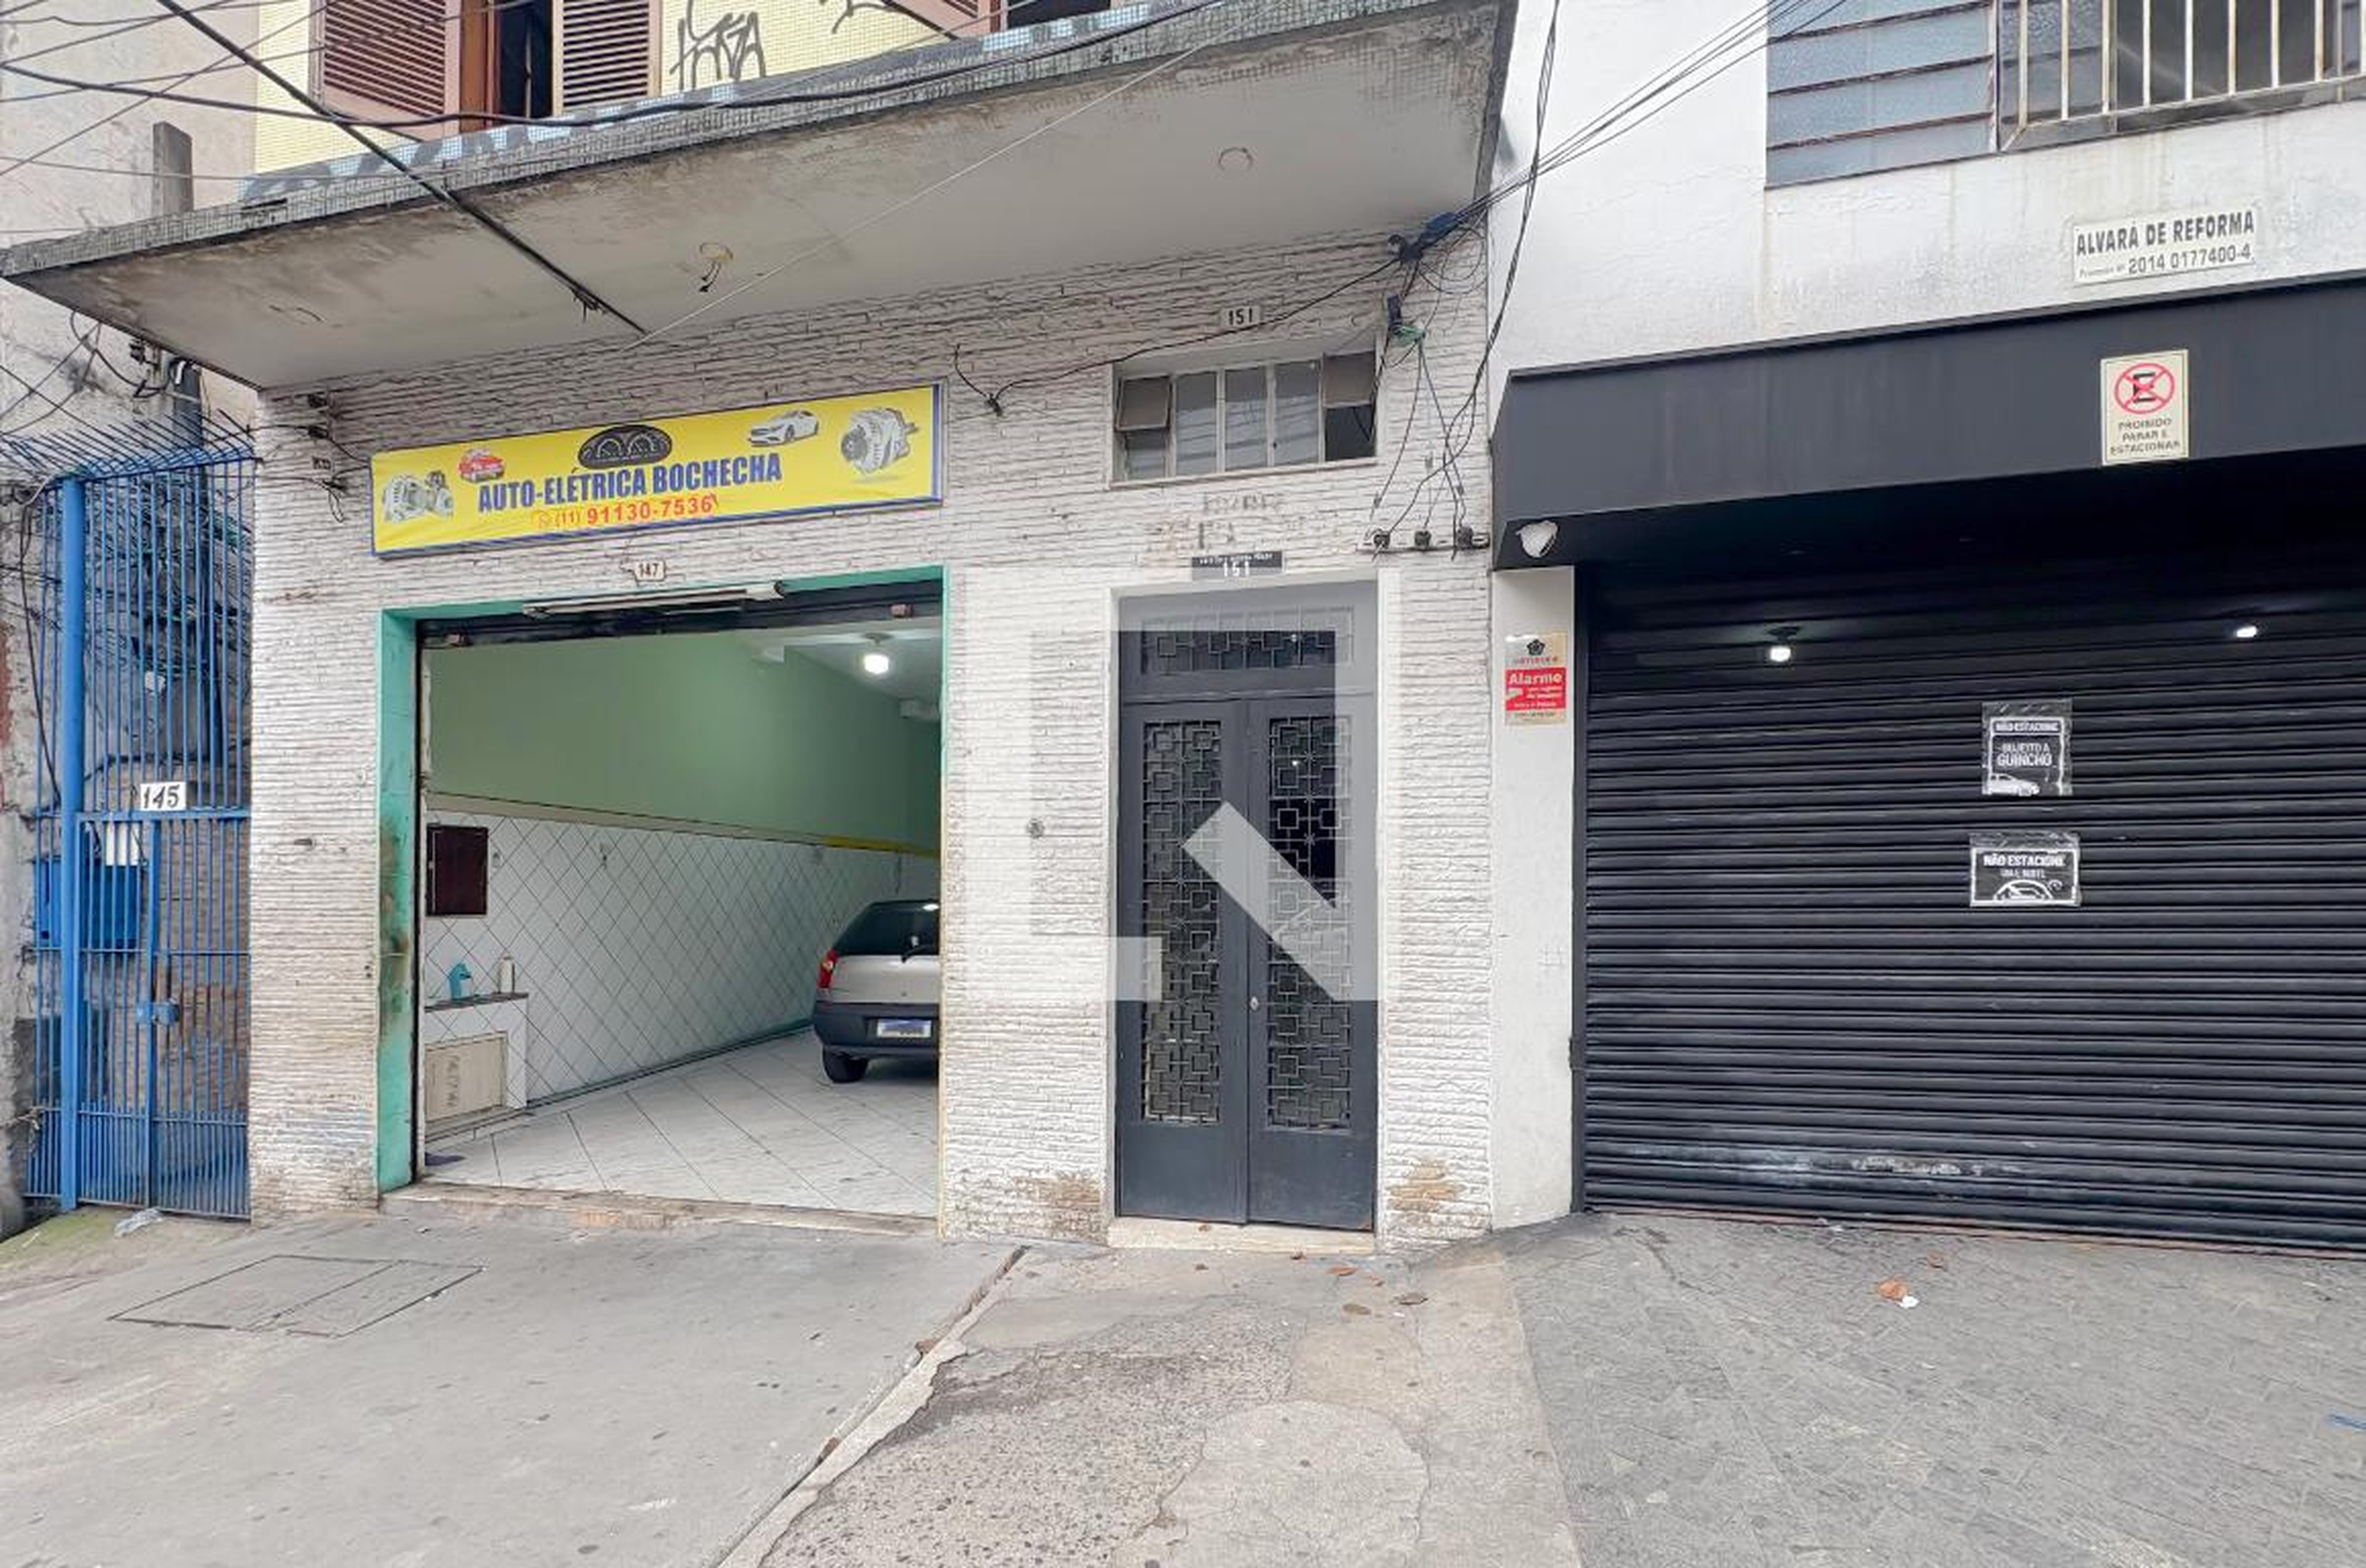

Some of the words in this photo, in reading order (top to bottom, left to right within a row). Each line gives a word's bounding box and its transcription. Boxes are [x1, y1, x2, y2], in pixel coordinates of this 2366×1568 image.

[2147, 222, 2166, 246] DE
[2173, 210, 2254, 242] REFORMA
[2128, 253, 2165, 275] 2014
[2170, 243, 2251, 269] 0177400-4
[1229, 308, 1253, 326] 151
[2118, 418, 2173, 431] PROIBIDO
[2110, 441, 2181, 456] ESTACIONAR
[478, 466, 646, 513] AUTO-ELÉTRICA
[653, 453, 782, 494] BOCHECHA
[587, 495, 712, 524] 91130-7536
[1223, 560, 1250, 577] 151
[1997, 752, 2052, 766] GUINCHO
[143, 784, 181, 808] 145
[1983, 853, 2006, 866] NÃO
